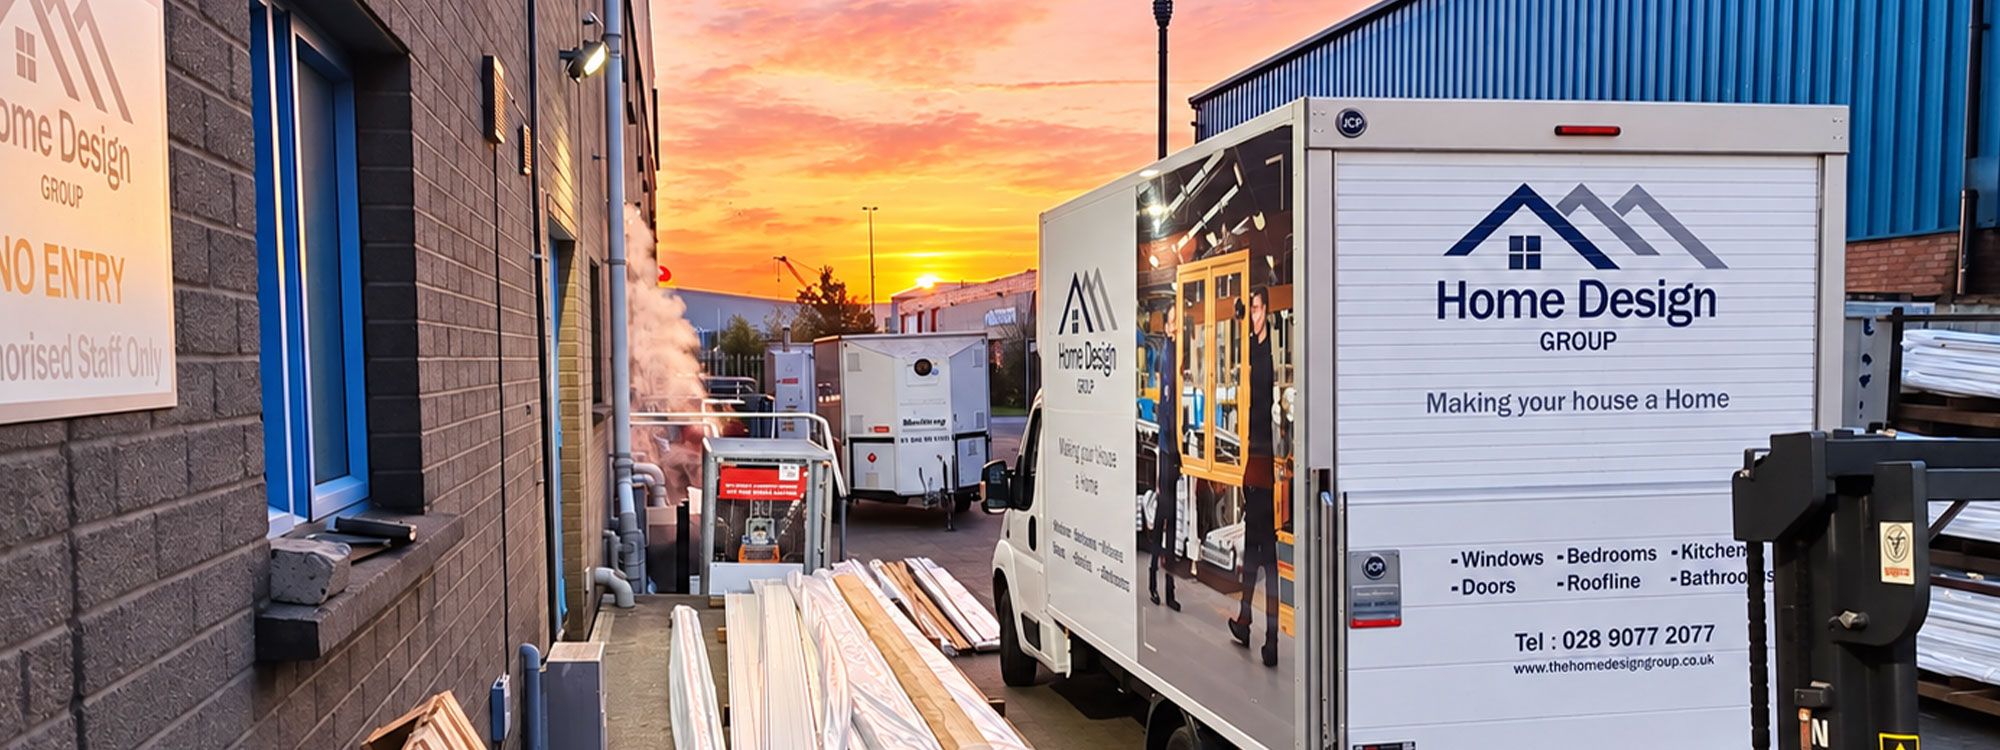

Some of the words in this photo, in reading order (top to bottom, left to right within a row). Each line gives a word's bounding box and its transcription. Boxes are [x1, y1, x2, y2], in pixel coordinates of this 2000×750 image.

[0, 97, 52, 157] ome
[59, 109, 131, 191] Design
[41, 174, 84, 208] GROUP
[44, 243, 125, 304] ENTRY
[1437, 280, 1565, 319] Home
[1578, 279, 1717, 327] Design
[1540, 331, 1617, 351] GROUP
[0, 331, 73, 381] orised
[78, 333, 122, 379] Staff
[126, 336, 162, 386] Only
[1426, 392, 1512, 417] Making
[1518, 395, 1566, 417] your
[1572, 391, 1638, 411] house
[1645, 394, 1658, 410] a
[1665, 389, 1730, 409] Home
[1671, 542, 1747, 559] -Kitchen
[1670, 569, 1775, 586] -Bathroos
[1515, 632, 1543, 652] Tel
[1562, 630, 1601, 650] 028
[1608, 627, 1659, 648] 9077
[1665, 625, 1715, 645] 2077
[1513, 654, 1715, 675] www.thehomedesigngroup.co.uk
